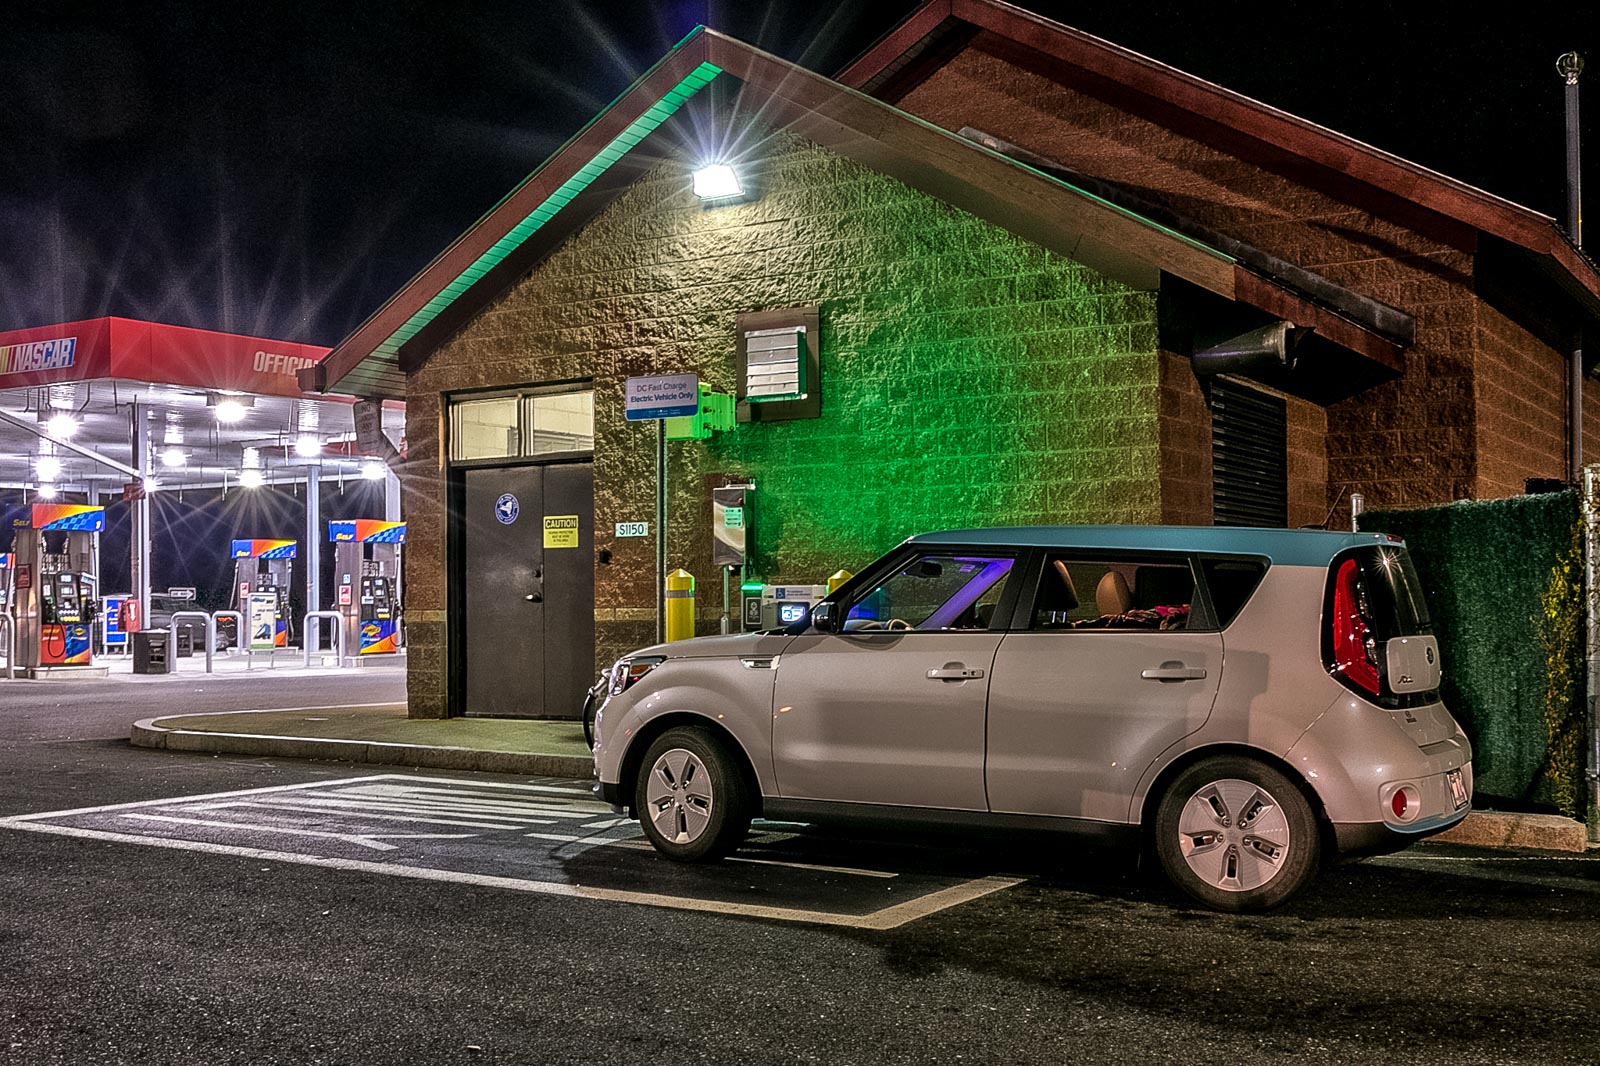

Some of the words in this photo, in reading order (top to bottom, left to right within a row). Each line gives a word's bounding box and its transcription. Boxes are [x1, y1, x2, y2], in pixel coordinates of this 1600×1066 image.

[13, 339, 72, 373] NASCAR
[636, 384, 648, 393] DC
[648, 383, 662, 392] Fast
[663, 381, 687, 391] Charge
[630, 394, 654, 403] Electric
[654, 392, 678, 401] Vehicle
[678, 391, 694, 401] Only
[361, 403, 371, 412] NO
[545, 519, 577, 529] CAUTION
[619, 523, 645, 536] S1150
